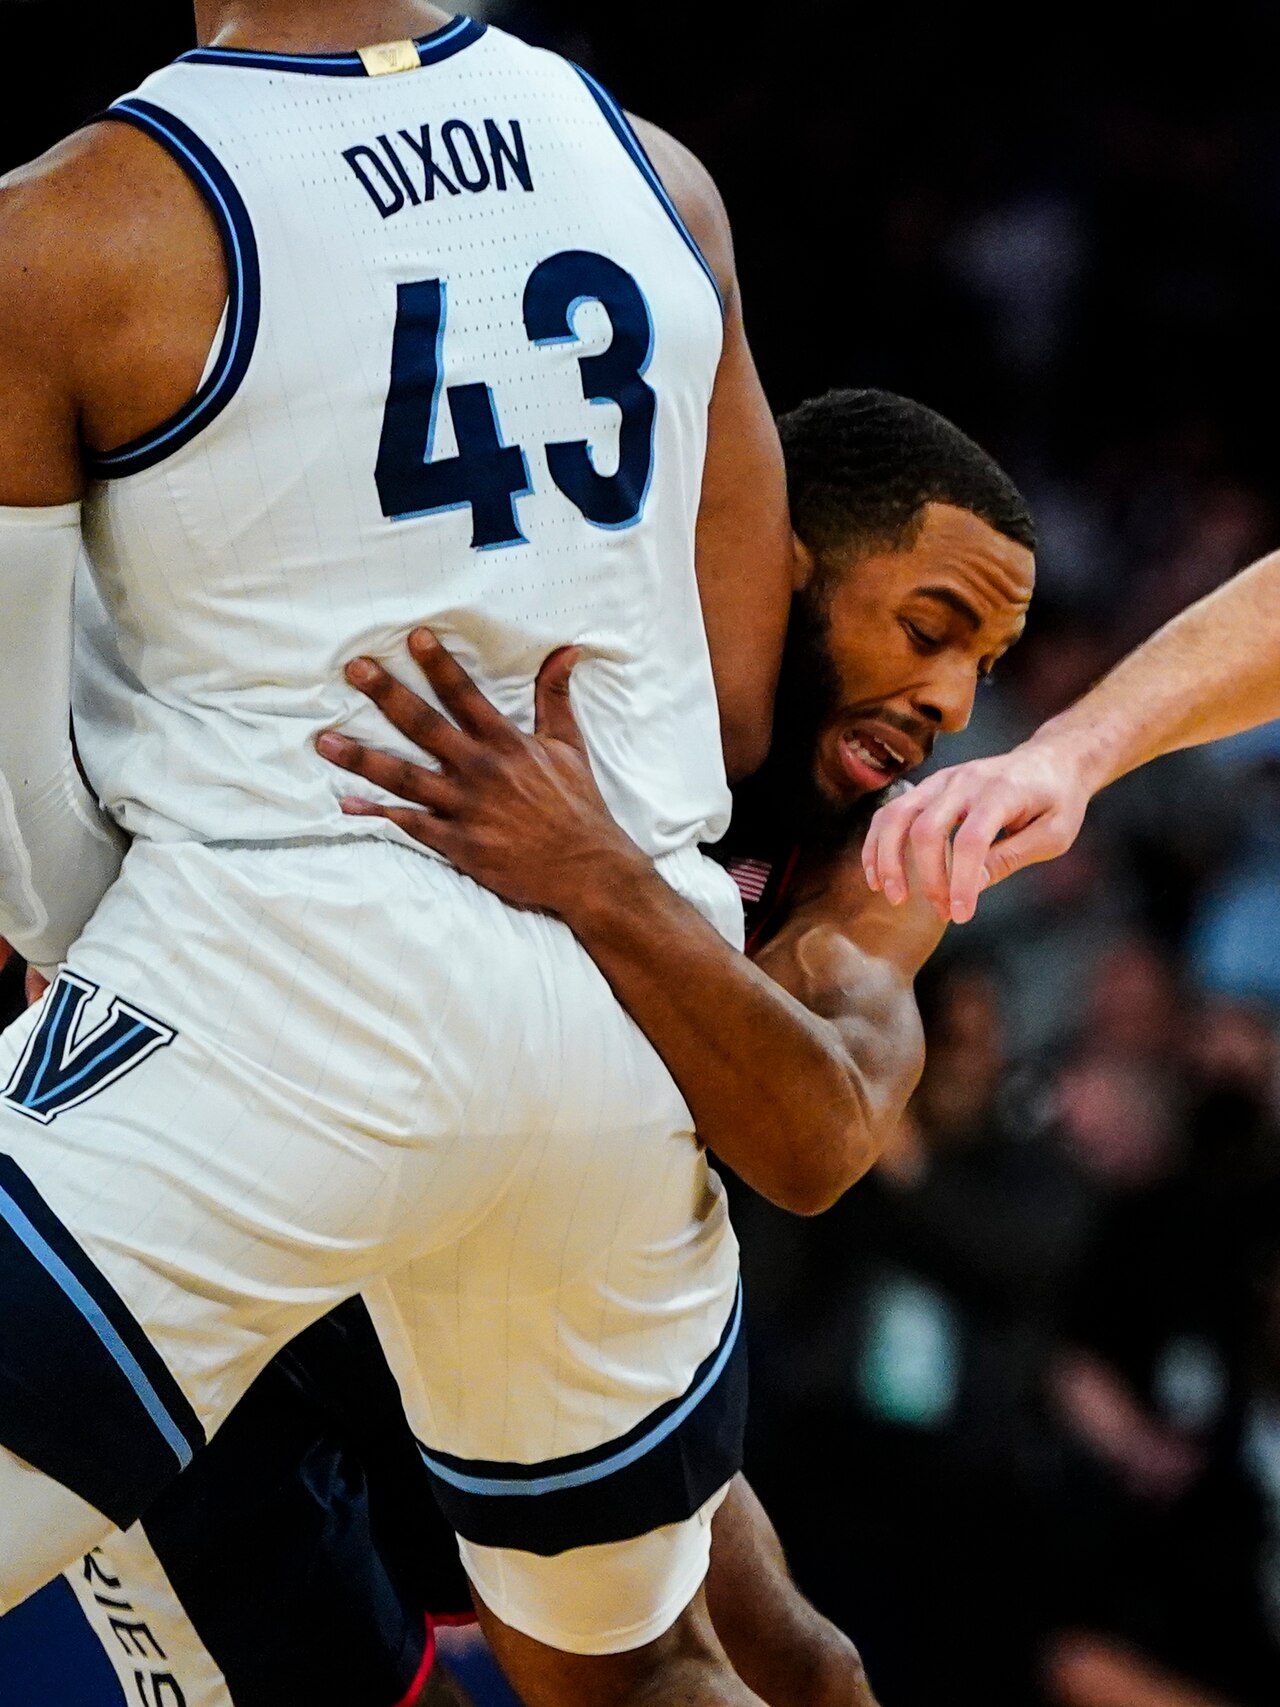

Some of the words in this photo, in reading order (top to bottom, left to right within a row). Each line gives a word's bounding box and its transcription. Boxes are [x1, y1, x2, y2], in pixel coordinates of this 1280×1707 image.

[341, 118, 534, 219] DIXON
[374, 249, 657, 552] 43
[0, 969, 178, 1126] V
